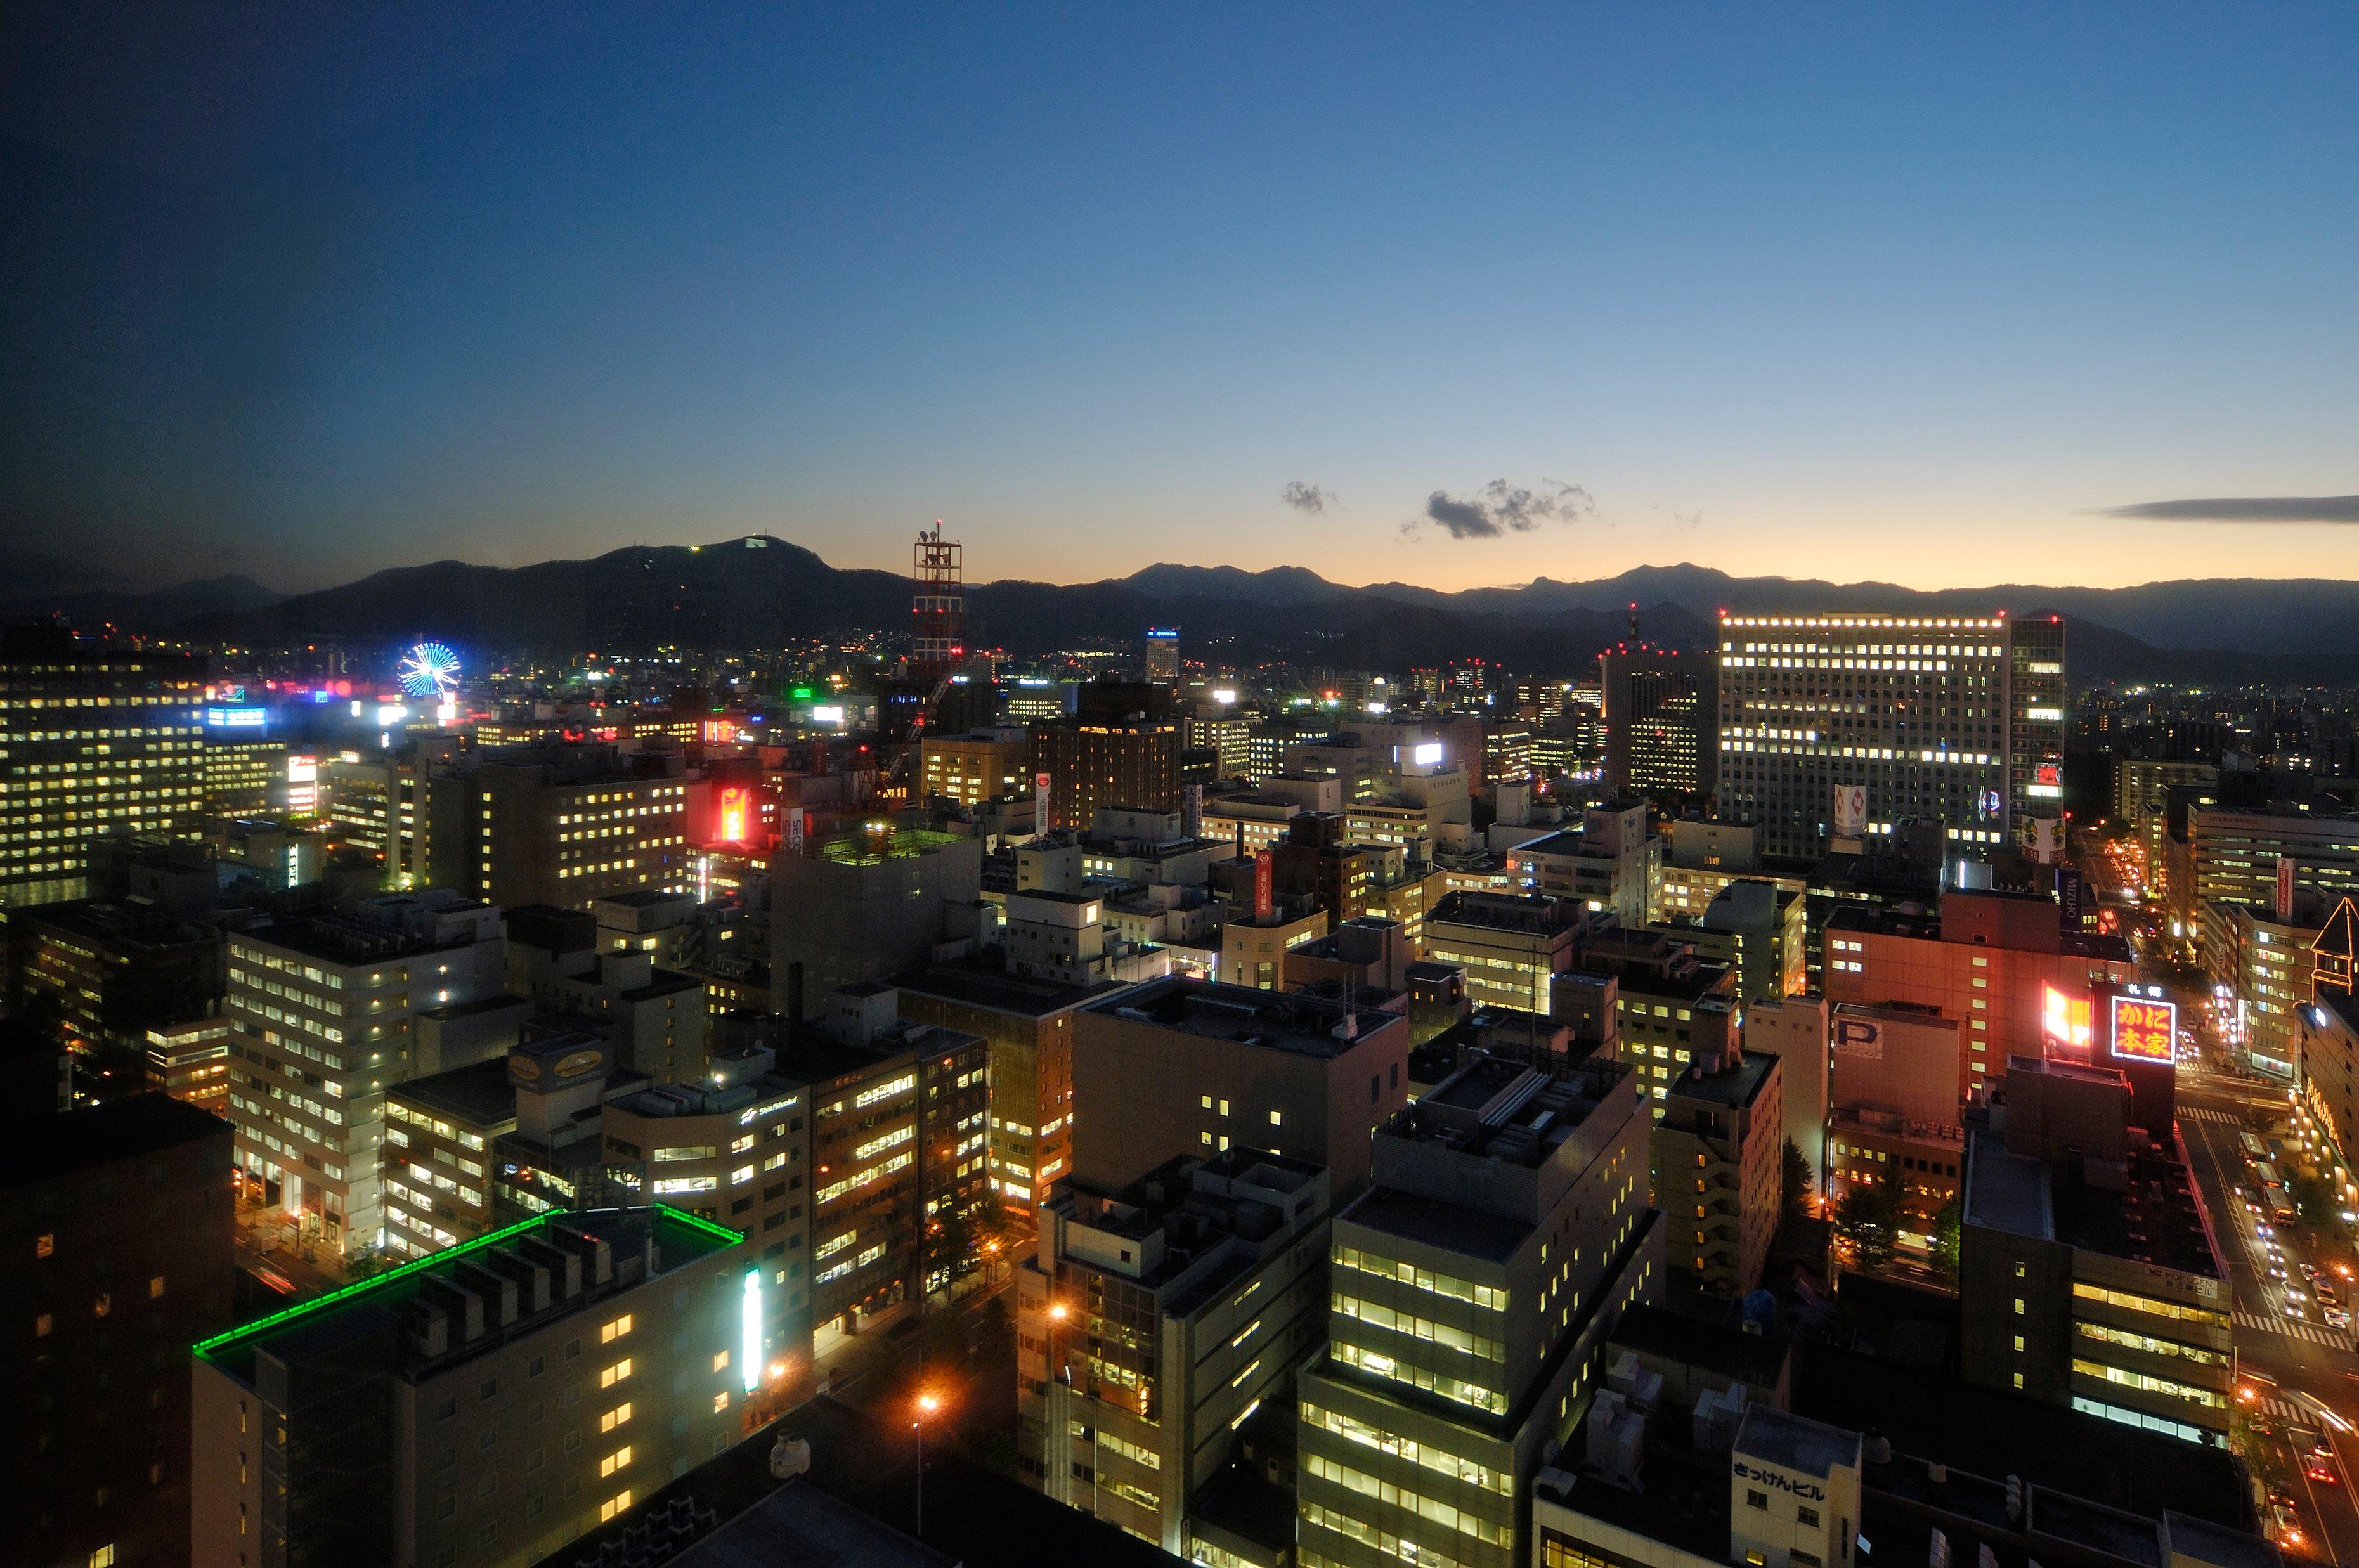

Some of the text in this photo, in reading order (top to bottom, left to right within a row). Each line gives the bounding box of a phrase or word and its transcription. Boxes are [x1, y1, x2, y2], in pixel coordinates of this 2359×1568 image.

[2067, 878, 2077, 919] MIZUHO
[2117, 1002, 2170, 1032] かに
[1838, 1020, 1878, 1046] P
[2115, 1027, 2172, 1058] 本家
[2165, 1271, 2213, 1288] HOKUSEN
